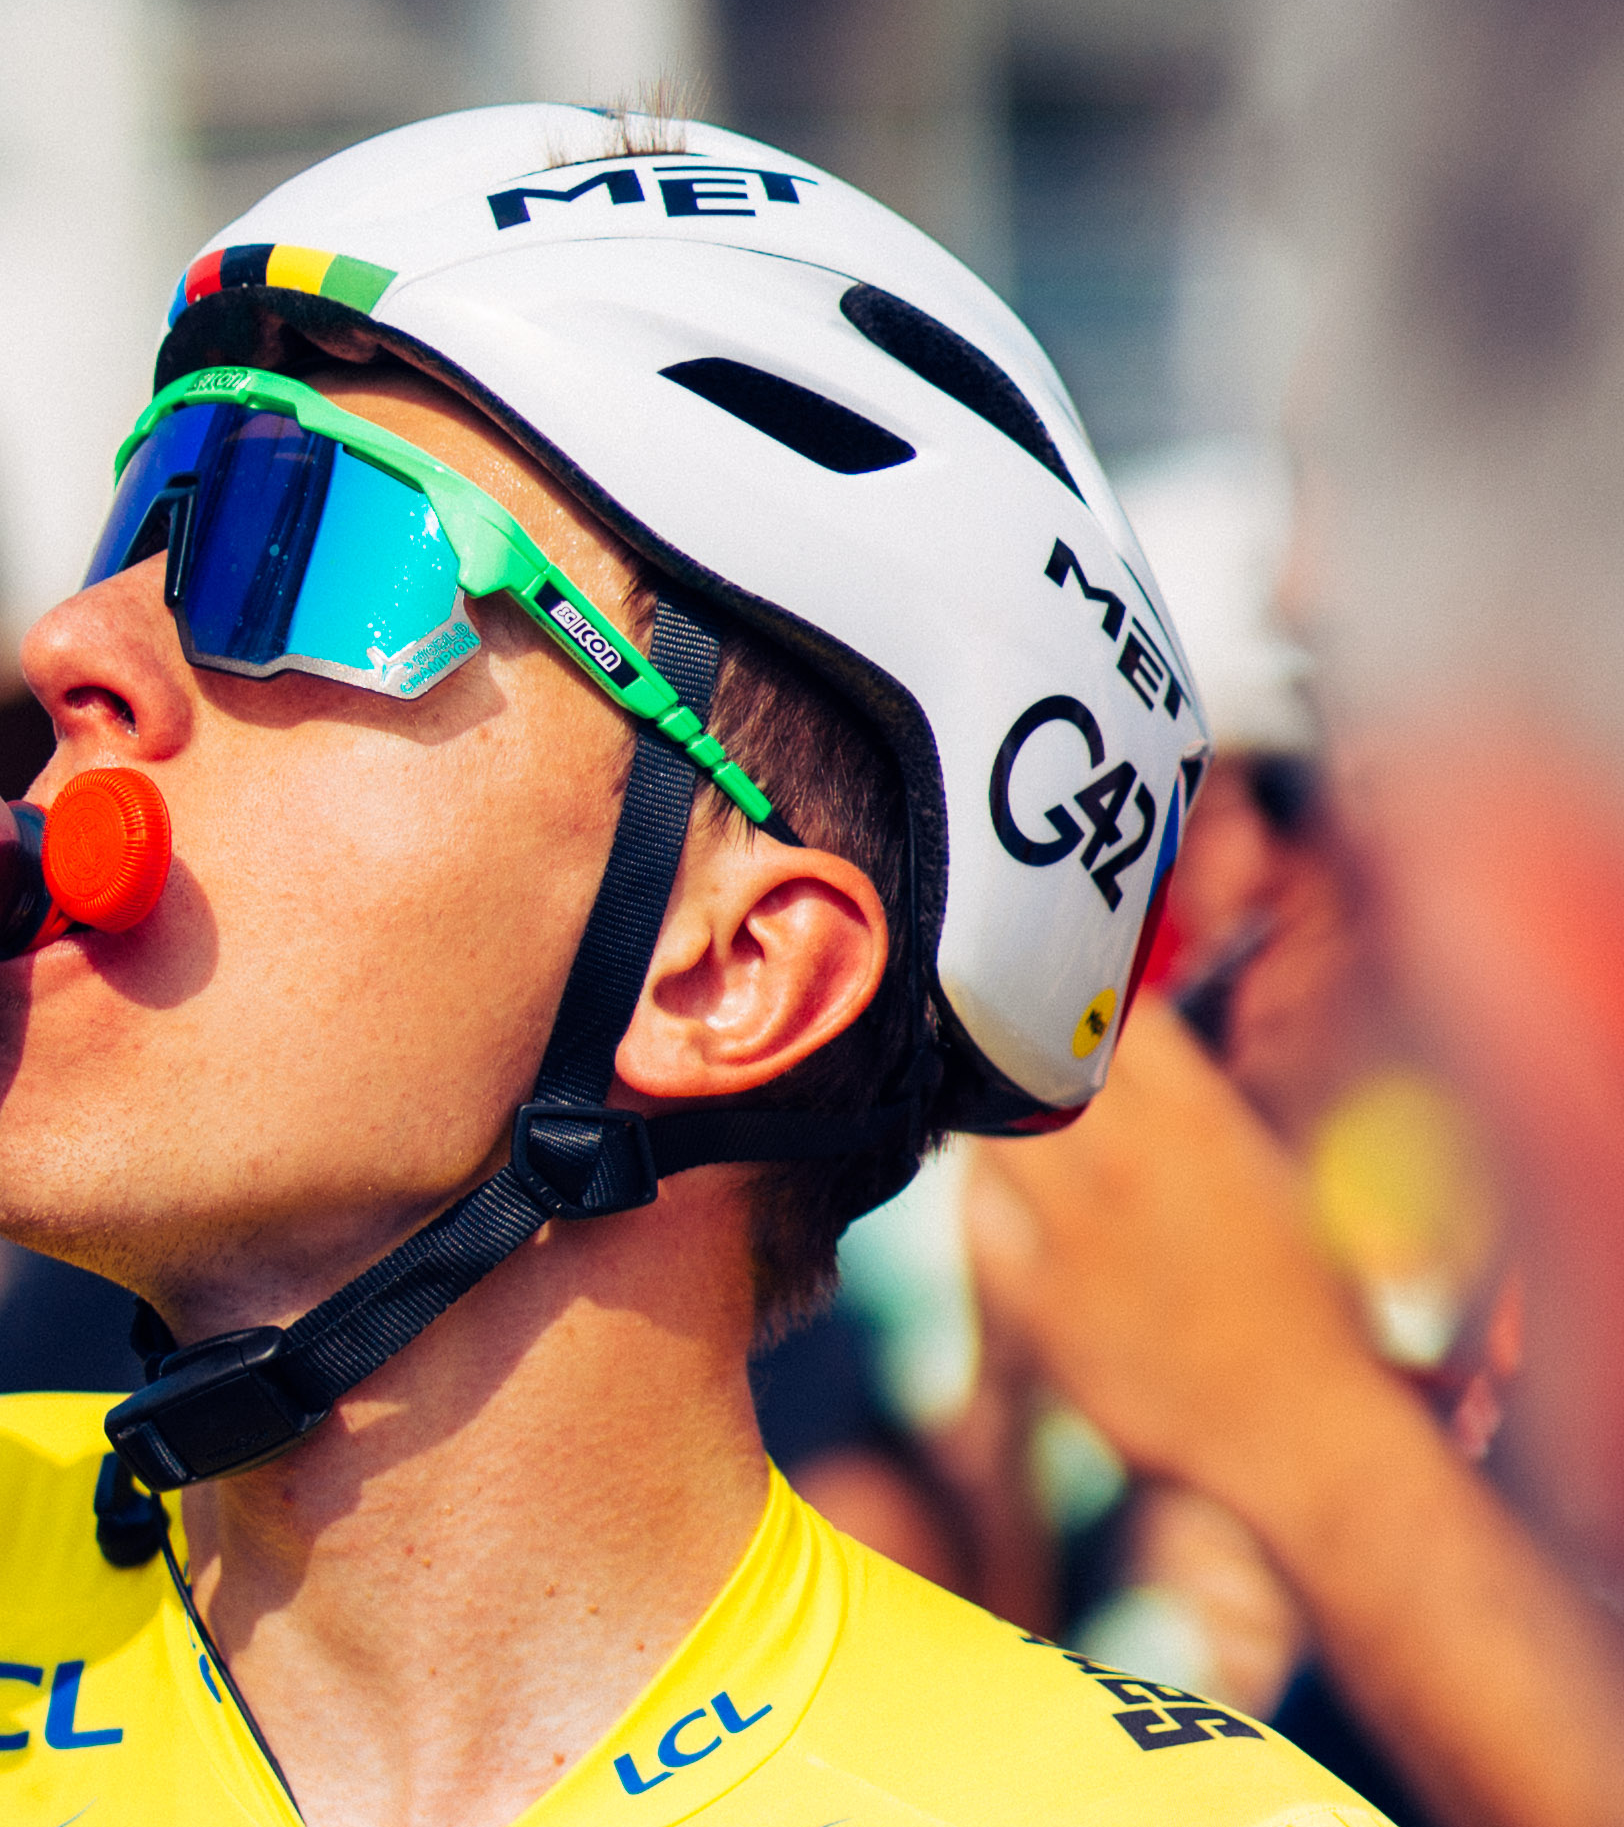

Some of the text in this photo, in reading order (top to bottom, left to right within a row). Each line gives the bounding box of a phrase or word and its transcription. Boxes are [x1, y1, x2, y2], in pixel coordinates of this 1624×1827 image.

[486, 166, 818, 230] MET
[400, 631, 481, 694] CHAMPION
[1043, 536, 1192, 720] MET
[989, 694, 1158, 913] G42
[613, 1690, 774, 1796] LCL
